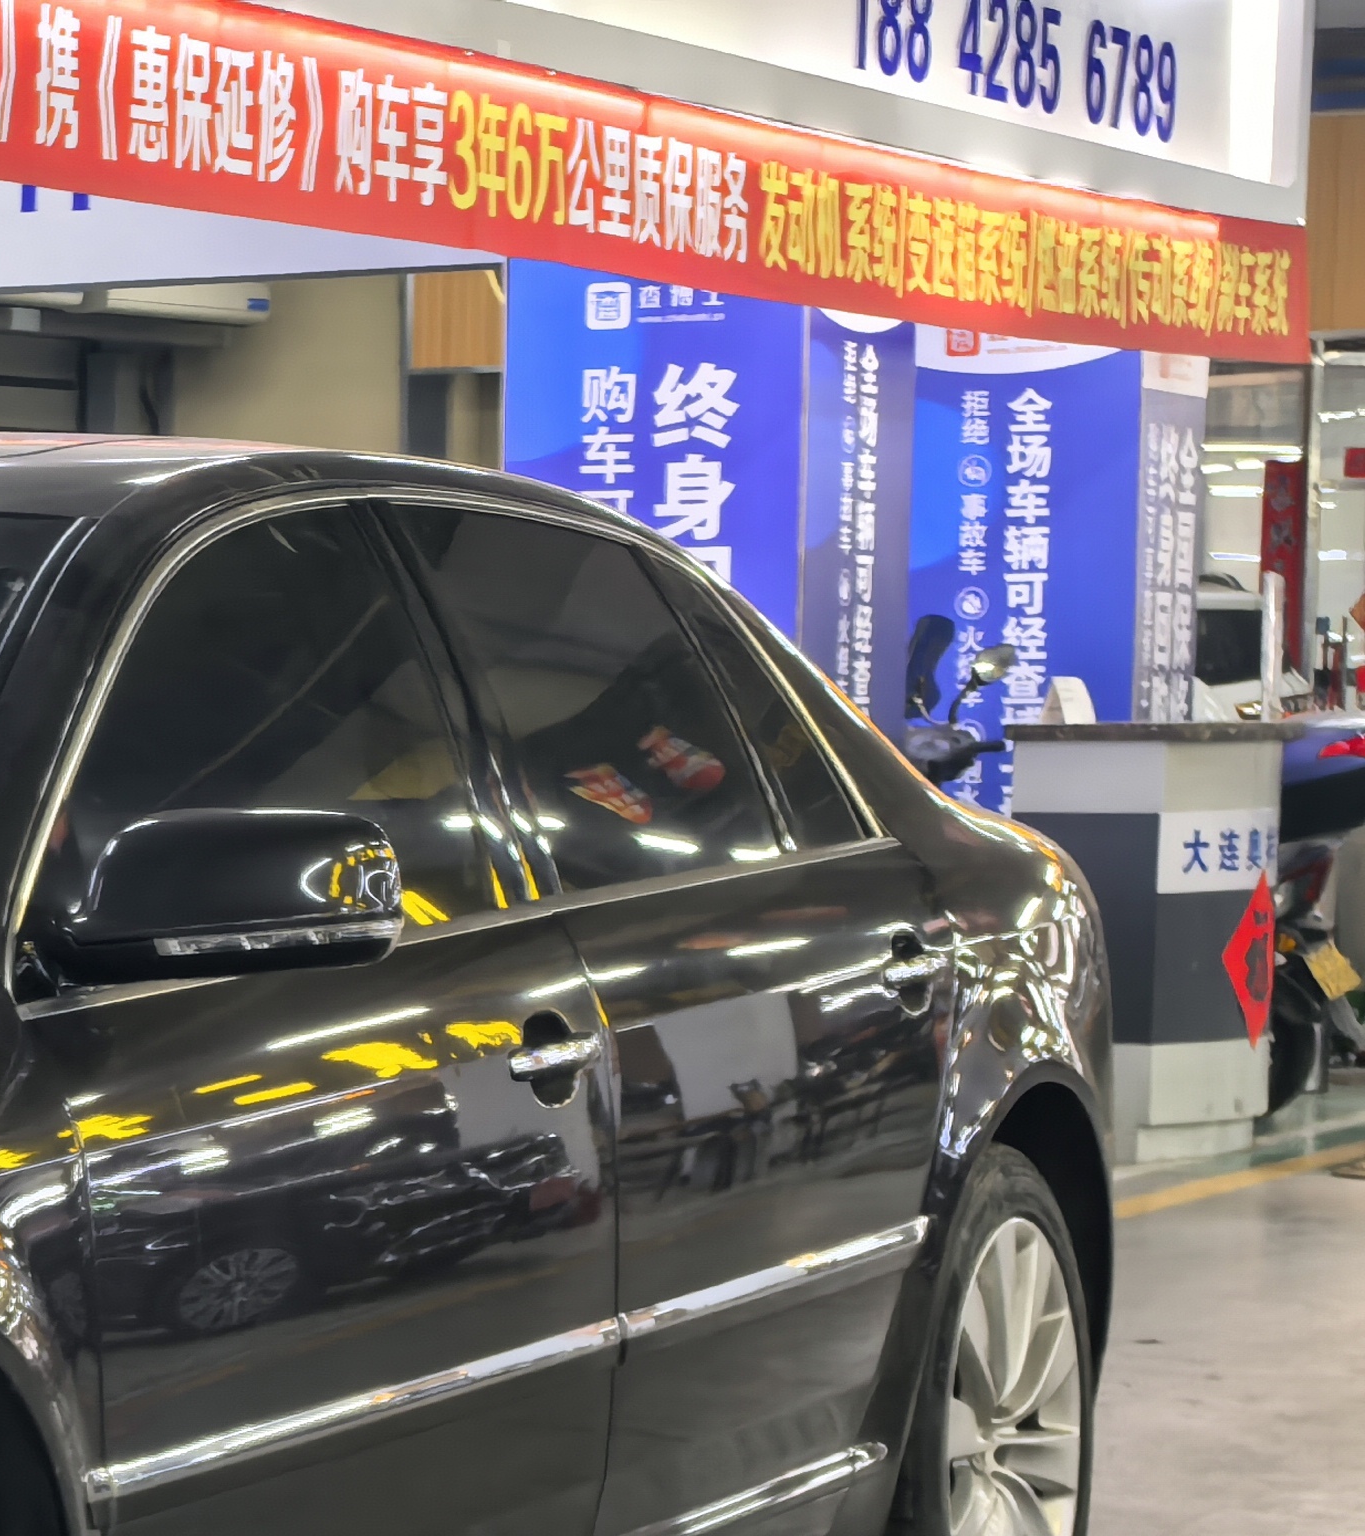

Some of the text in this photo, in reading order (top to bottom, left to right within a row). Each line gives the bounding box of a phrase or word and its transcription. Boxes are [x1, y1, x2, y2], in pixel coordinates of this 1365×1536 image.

[855, 0, 1178, 144] 188 4285 6789
[957, 493, 989, 576] 事故车
